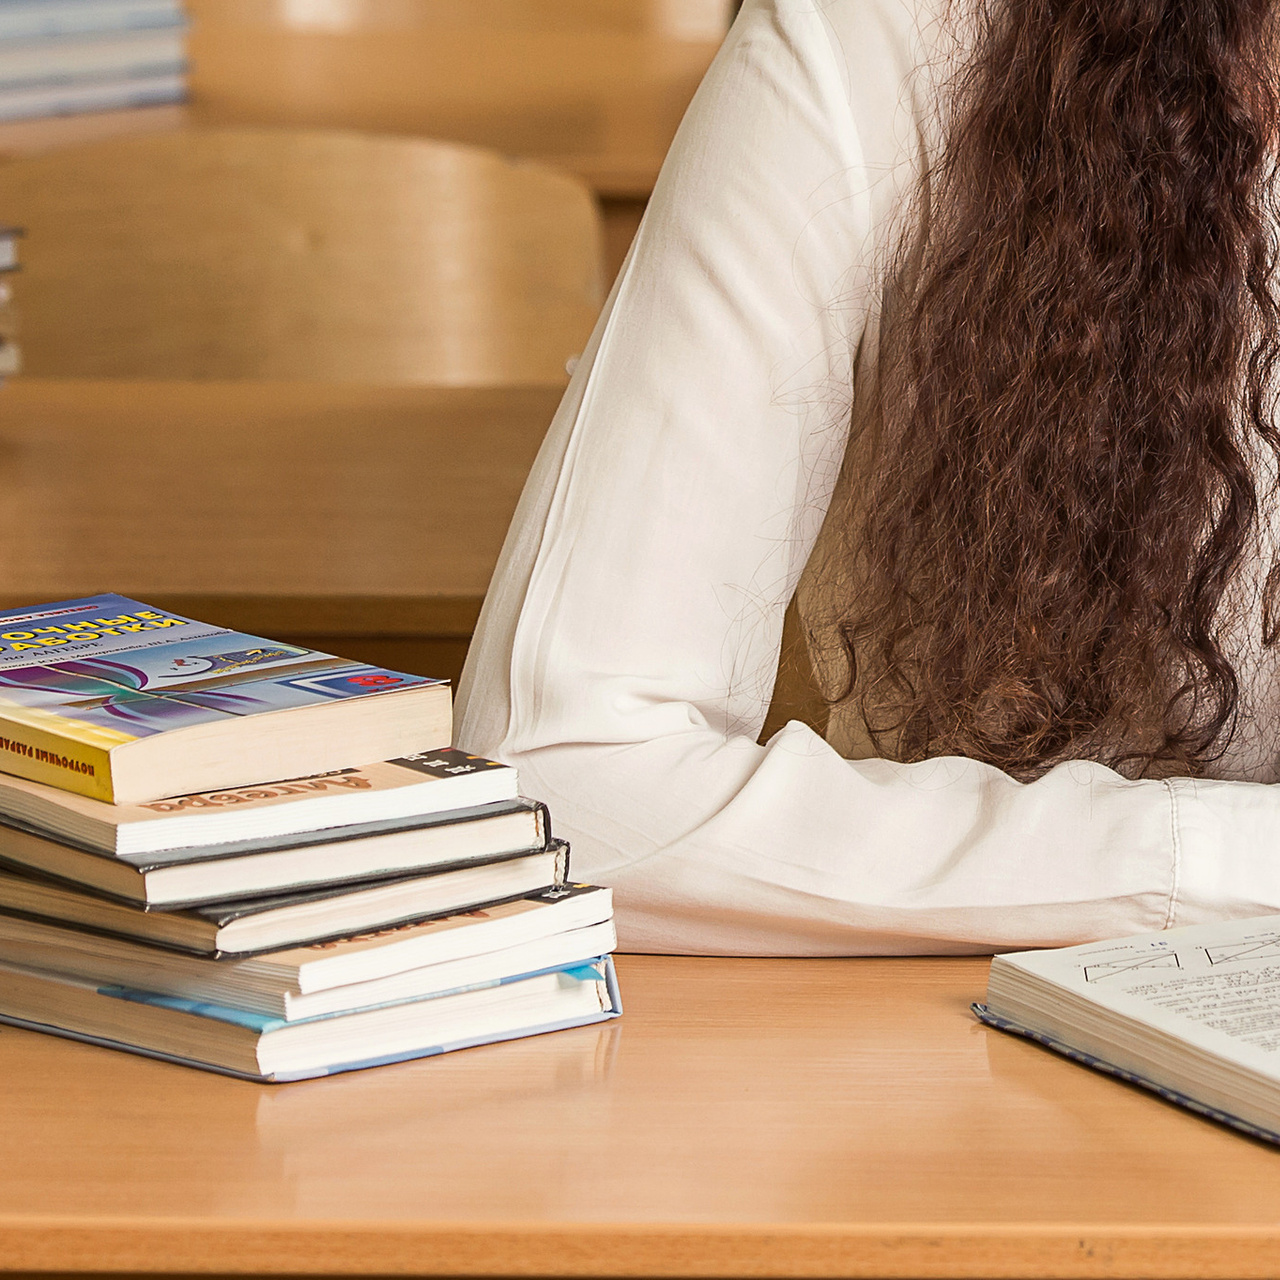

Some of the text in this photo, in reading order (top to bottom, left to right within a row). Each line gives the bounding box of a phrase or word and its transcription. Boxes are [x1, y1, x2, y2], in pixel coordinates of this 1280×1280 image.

[0, 617, 188, 654] АБОТКИ
[1, 610, 166, 641] ОЧНЫЕ
[347, 674, 404, 688] 8
[35, 748, 95, 777] ПОУРОЧНЫЕ
[136, 776, 373, 814] Алгебра
